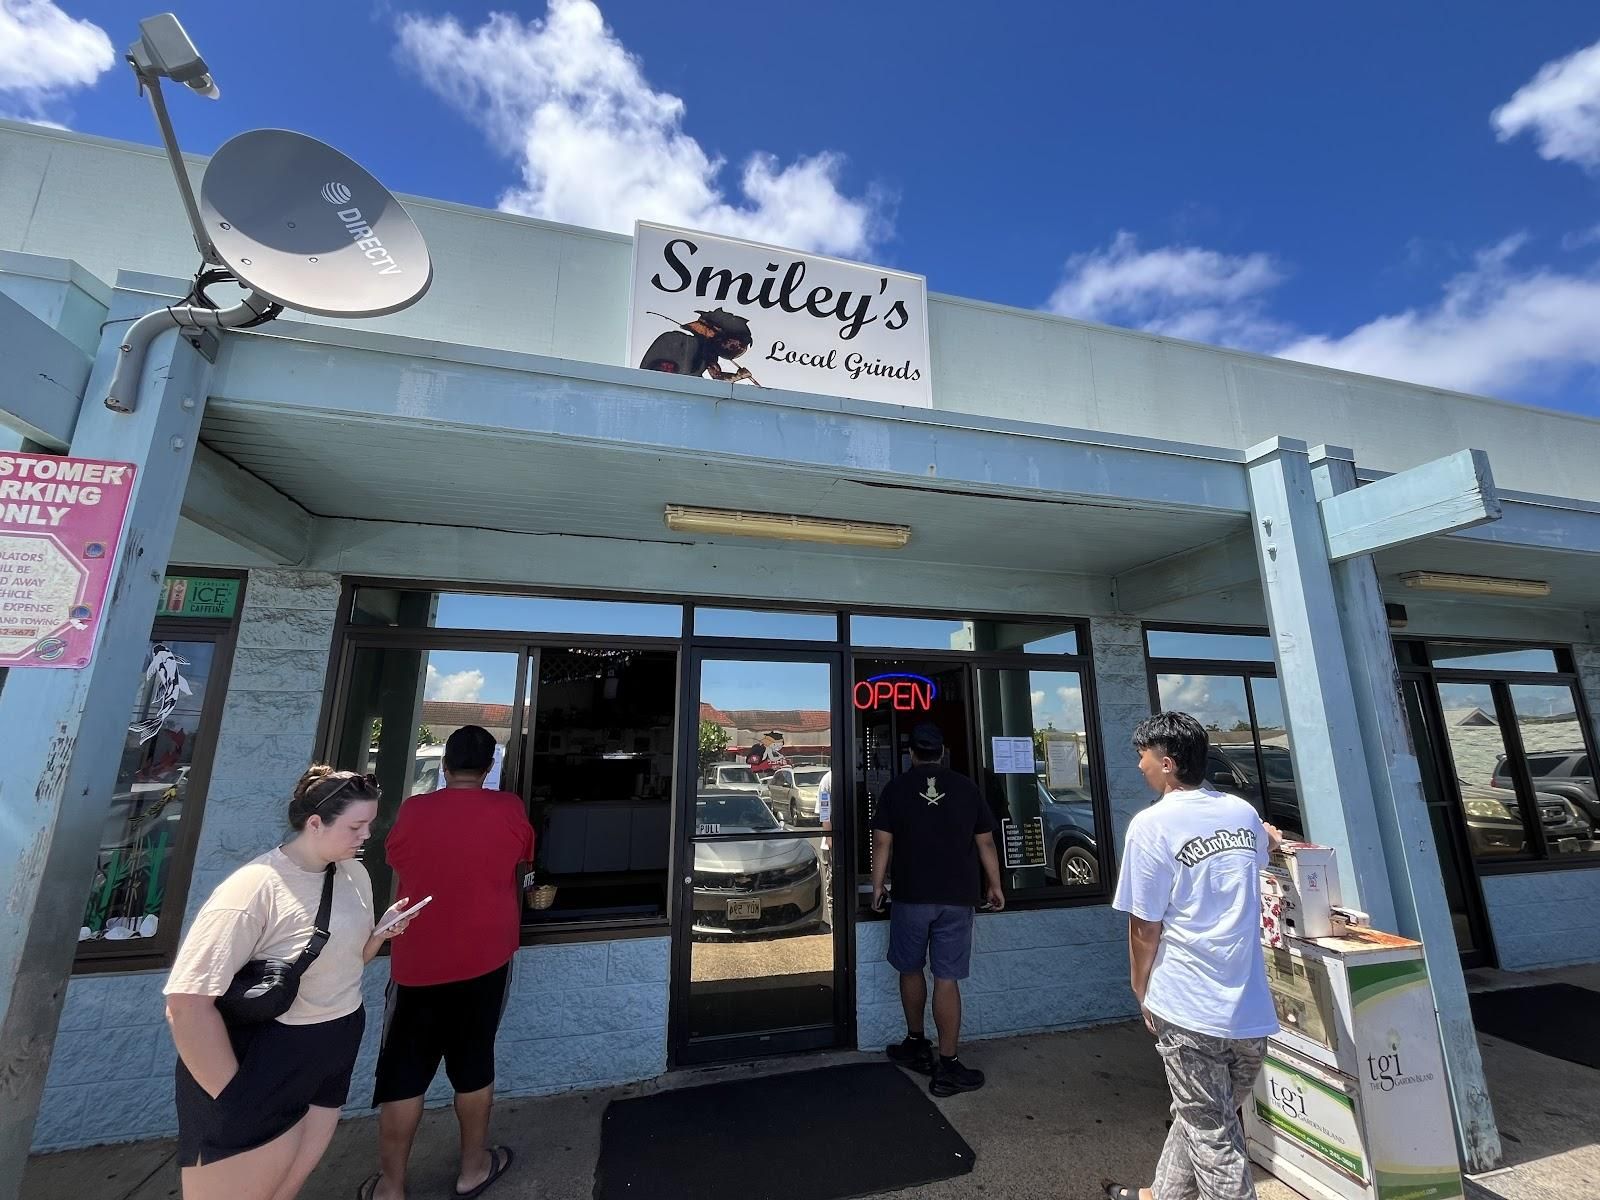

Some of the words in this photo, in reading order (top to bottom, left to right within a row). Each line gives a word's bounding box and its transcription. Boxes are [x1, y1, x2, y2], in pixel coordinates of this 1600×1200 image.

[337, 207, 402, 277] DIRECTV
[651, 239, 909, 340] Smiley's
[766, 340, 837, 370] Local
[844, 352, 921, 381] Grinds
[0, 480, 101, 506] RKING
[0, 552, 44, 562] LATORS
[16, 565, 31, 574] BE
[11, 577, 46, 587] AWAY
[192, 586, 228, 603] ICE
[3, 602, 54, 613] EXPENSE
[191, 605, 225, 613] CAFFEINE
[20, 617, 60, 626] TOWING
[853, 681, 931, 710] OPEN
[700, 824, 719, 833] PULL
[1367, 1043, 1403, 1091] tgi
[1268, 1076, 1308, 1119] tgi
